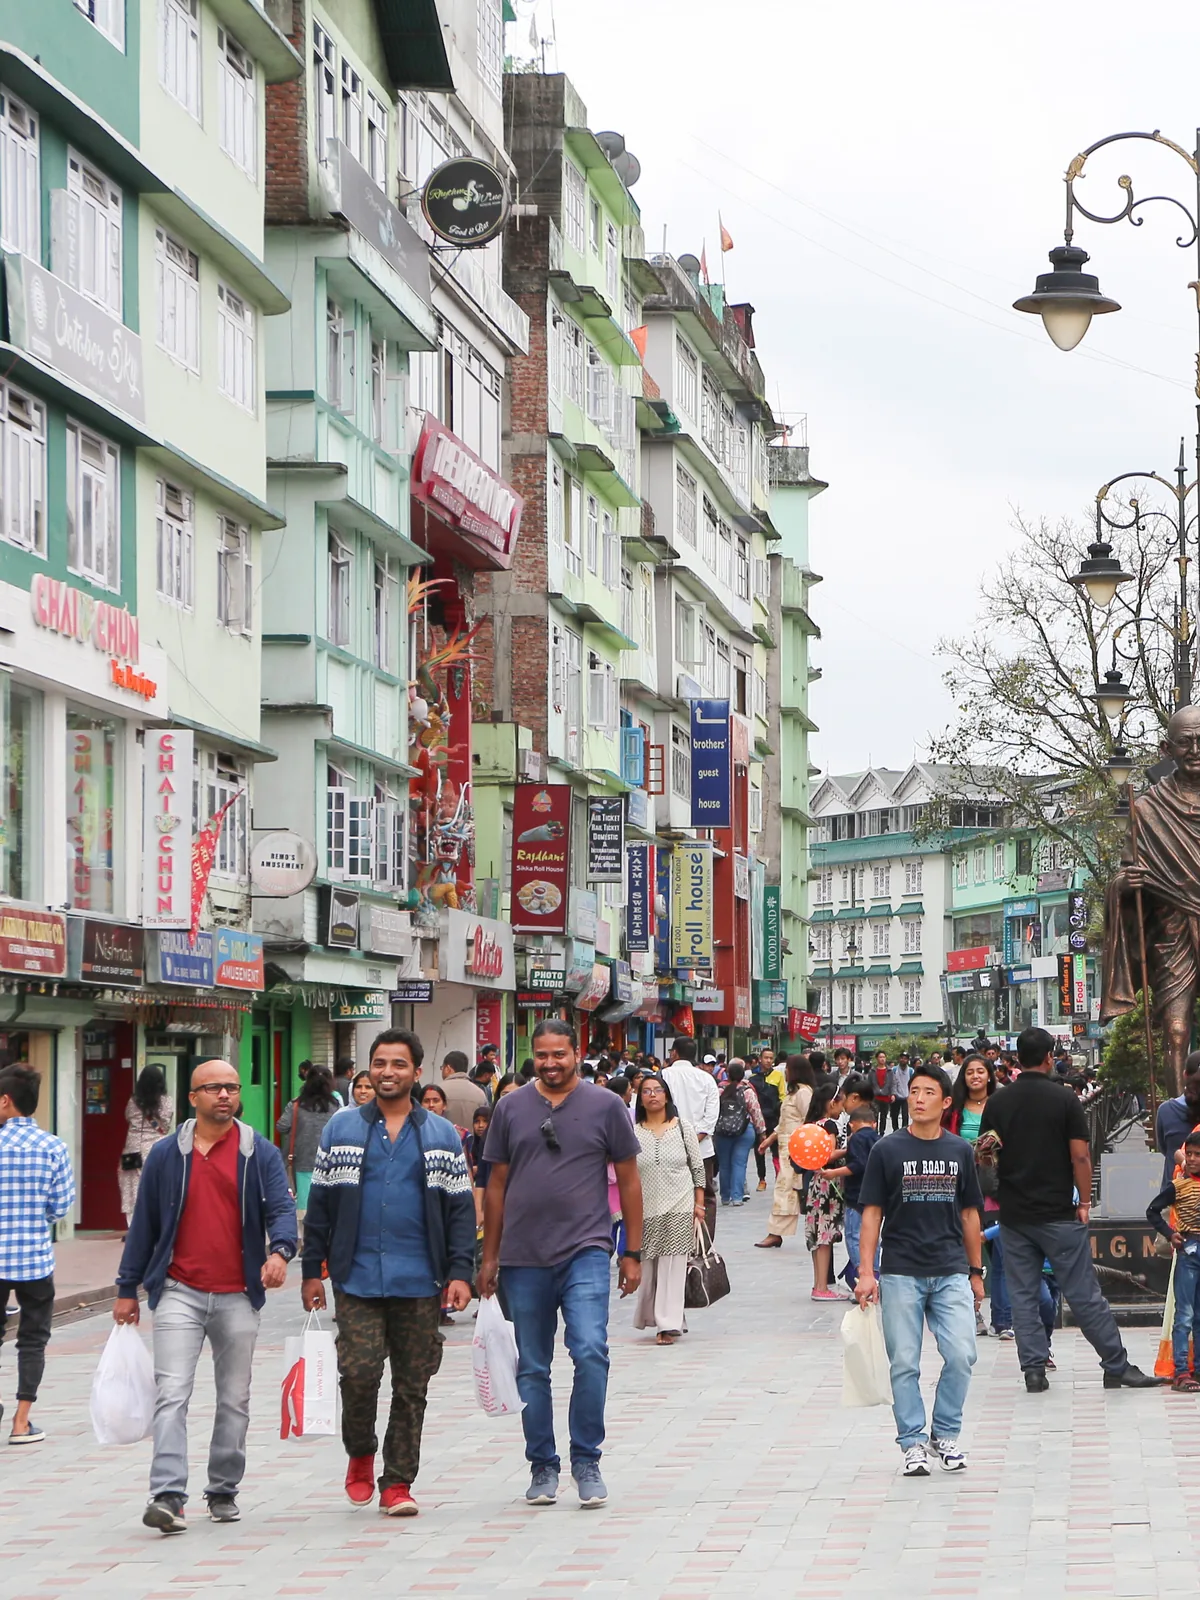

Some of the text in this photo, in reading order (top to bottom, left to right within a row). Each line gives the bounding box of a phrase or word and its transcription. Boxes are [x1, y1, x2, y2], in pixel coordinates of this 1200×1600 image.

[449, 224, 468, 236] Food
[475, 221, 489, 233] Bar
[107, 329, 141, 399] Sky
[31, 573, 140, 666] CHAI CHUN
[693, 738, 727, 749] brothers'
[158, 734, 174, 812] CHAI
[698, 768, 719, 779] guest
[698, 798, 721, 809] house
[592, 833, 619, 841] DOMESTIC
[261, 861, 304, 870] AMUSEMENT
[516, 850, 565, 863] Rajdhani
[157, 835, 173, 915] CHUN
[632, 850, 642, 887] LAXMI
[685, 852, 703, 910] house
[159, 917, 187, 926] Boutique
[632, 892, 643, 936] SWEETS
[685, 922, 703, 956] roll
[768, 909, 778, 971] WOODLAND
[221, 964, 259, 983] AMUSEMENT
[534, 971, 563, 980] PHOTO
[1074, 954, 1083, 979] Court
[532, 979, 563, 988] STUDIO
[1076, 981, 1084, 1003] Food
[340, 1006, 366, 1016] BAR
[479, 1008, 490, 1041] ROLL
[903, 1160, 959, 1175] MY ROAD TO
[902, 1175, 957, 1192] SUCCESS
[1110, 1236, 1132, 1257] G.
[316, 1350, 324, 1398] www.bata.in
